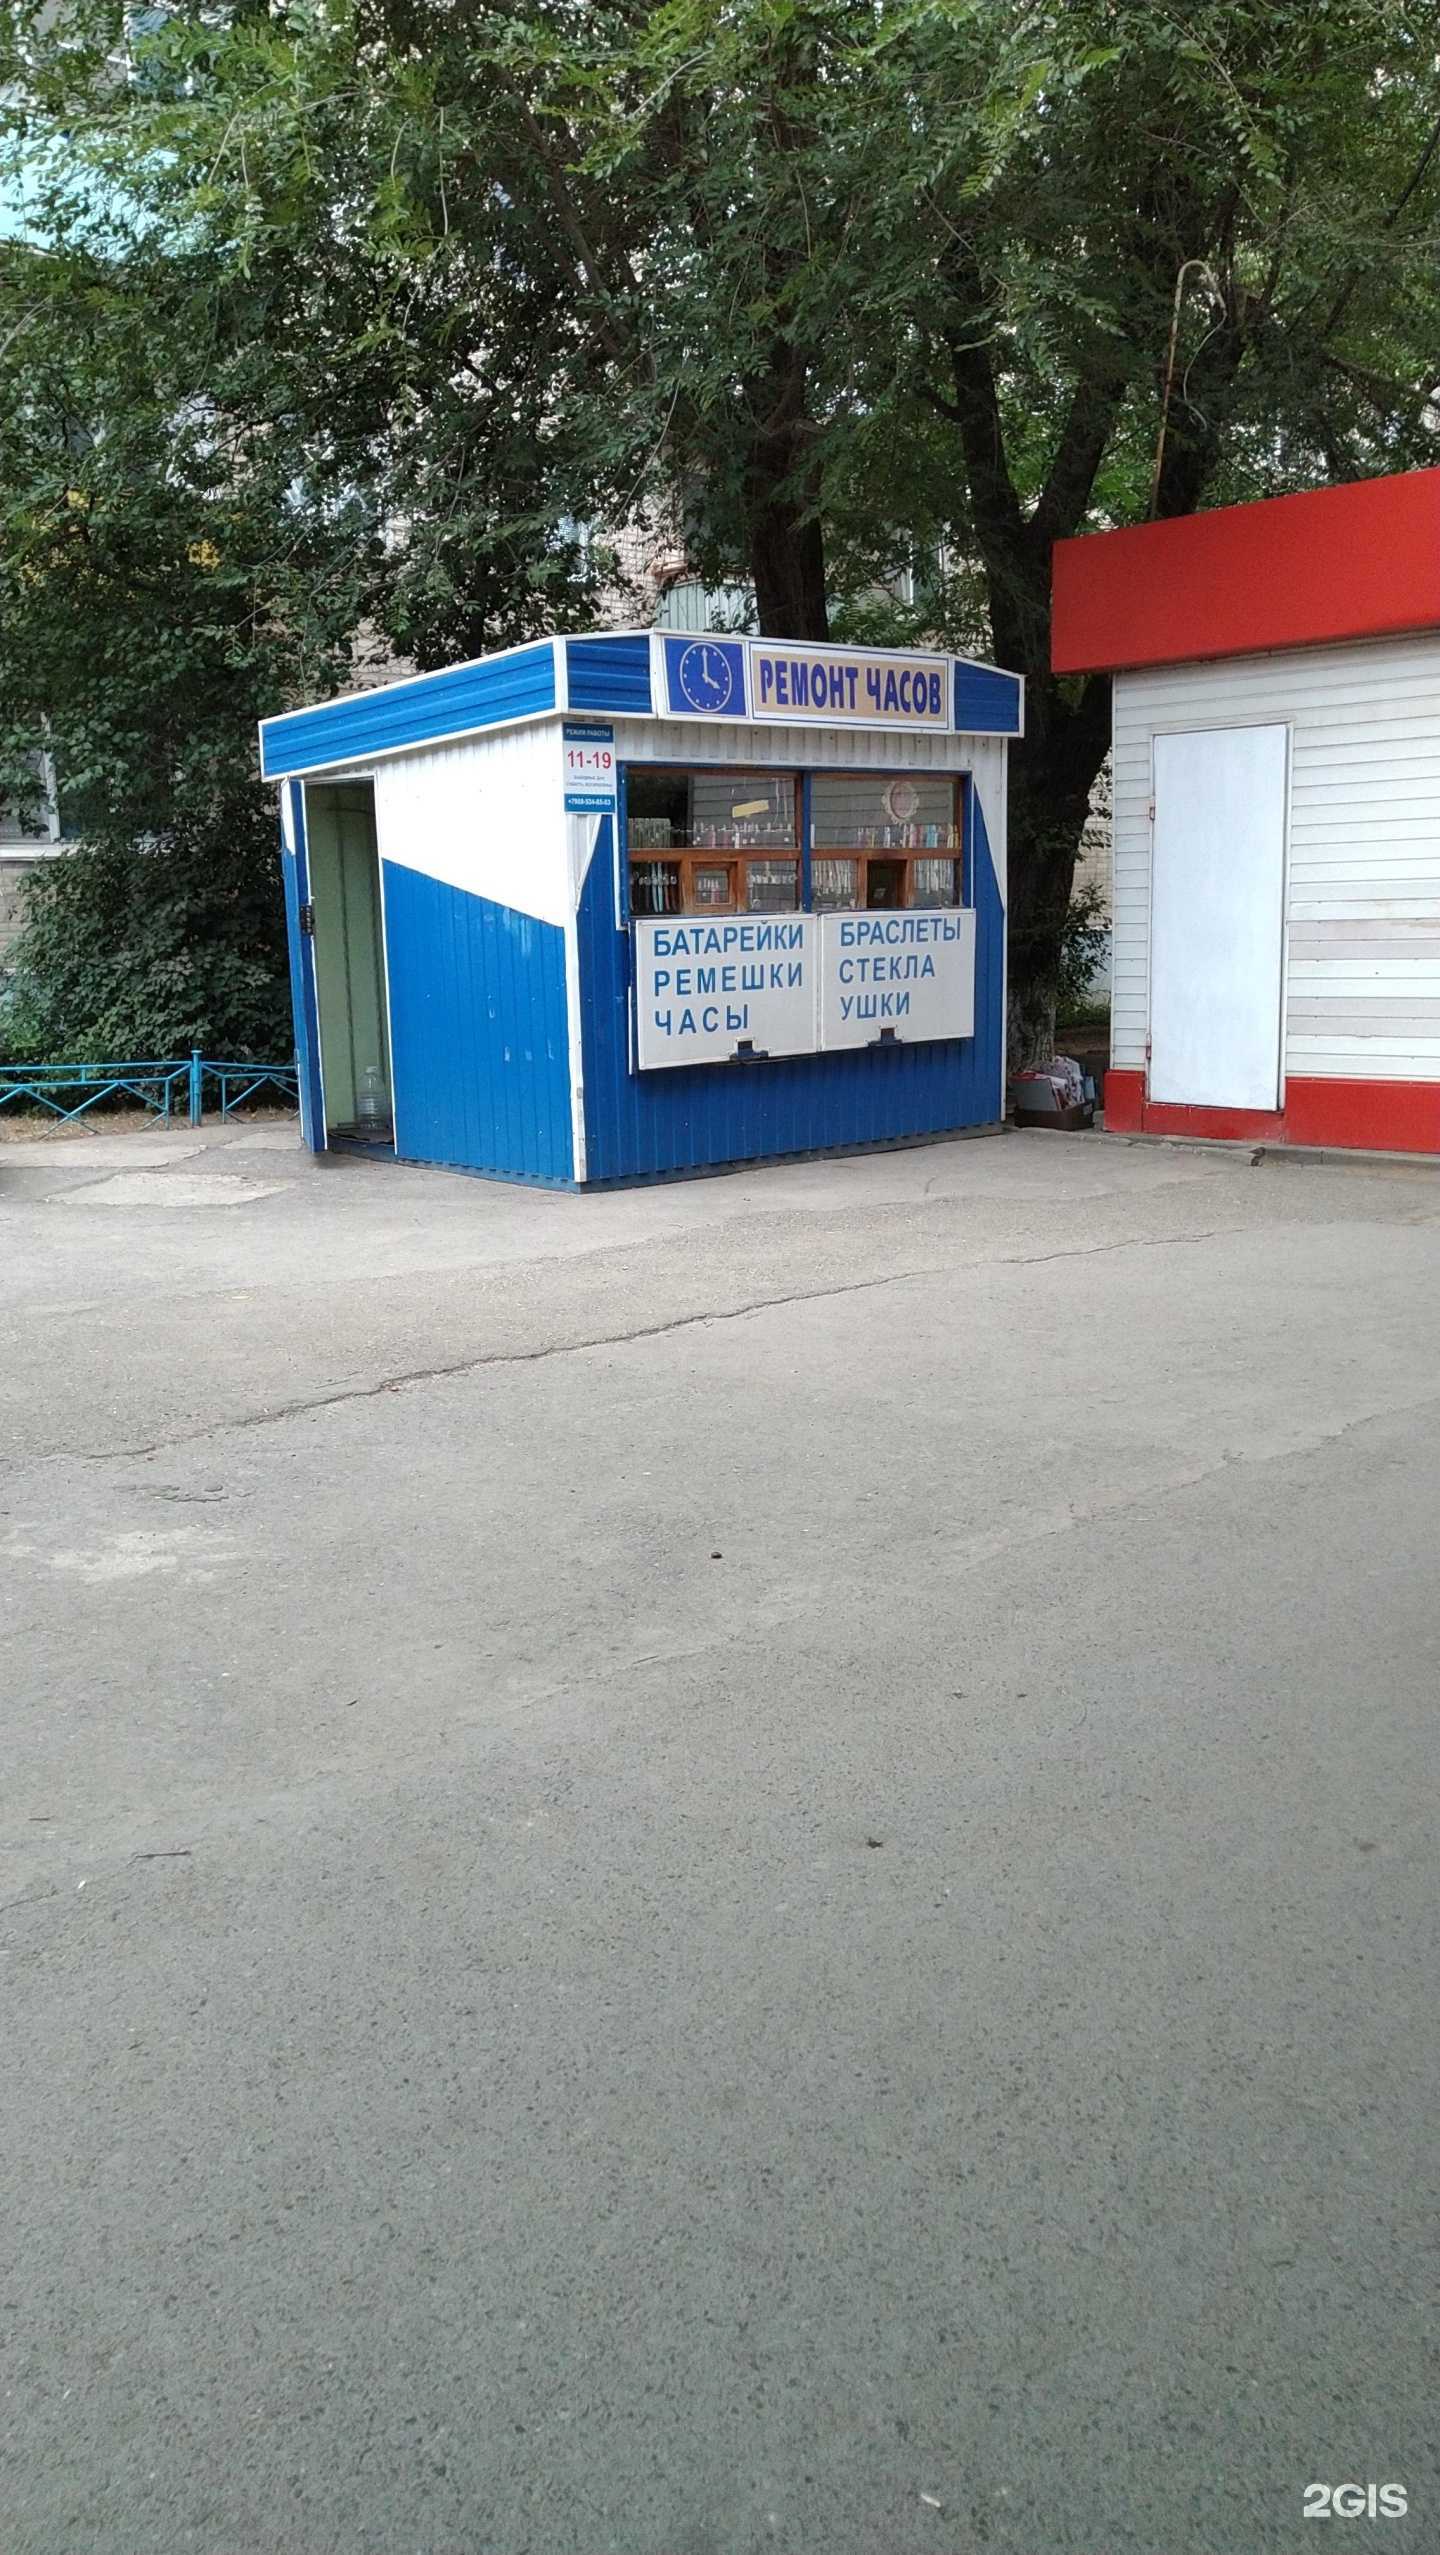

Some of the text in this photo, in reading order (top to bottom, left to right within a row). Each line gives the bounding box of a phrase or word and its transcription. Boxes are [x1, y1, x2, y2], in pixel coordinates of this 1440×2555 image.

[760, 658, 942, 715] РЕМОНТ ЧАСОВ
[567, 750, 612, 769] 11-19
[653, 920, 804, 957] БАТАРЕЙКИ
[839, 916, 961, 947] БРАСЛЕТЫ
[653, 962, 803, 997] РЕМЕШКИ
[838, 953, 936, 984] СТЕКЛА
[654, 1003, 750, 1036] ЧАСЫ
[839, 991, 911, 1021] УШКИ
